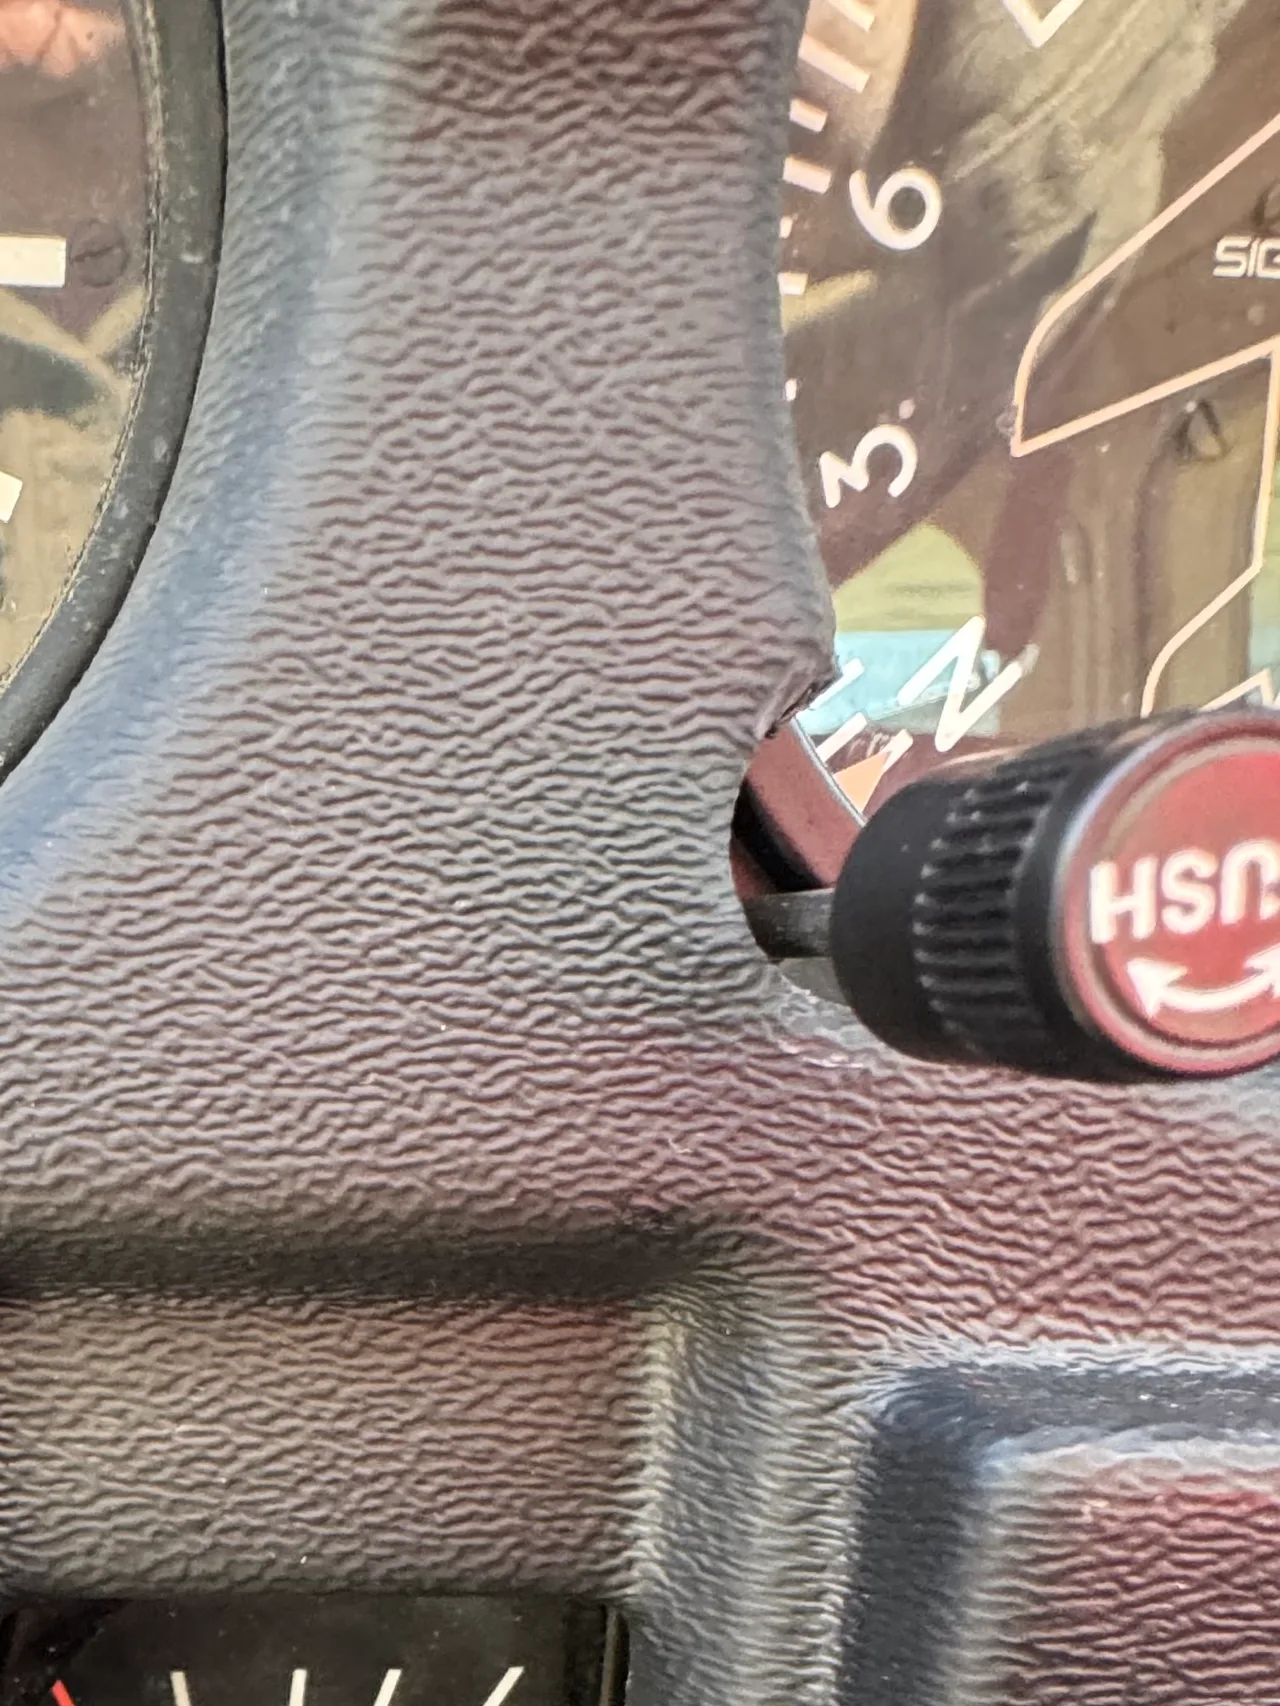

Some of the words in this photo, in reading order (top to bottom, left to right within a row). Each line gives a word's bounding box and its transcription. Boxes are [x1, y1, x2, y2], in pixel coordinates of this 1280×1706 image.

[848, 166, 943, 251] 6
[818, 423, 919, 508] 3
[896, 614, 1041, 753] N
